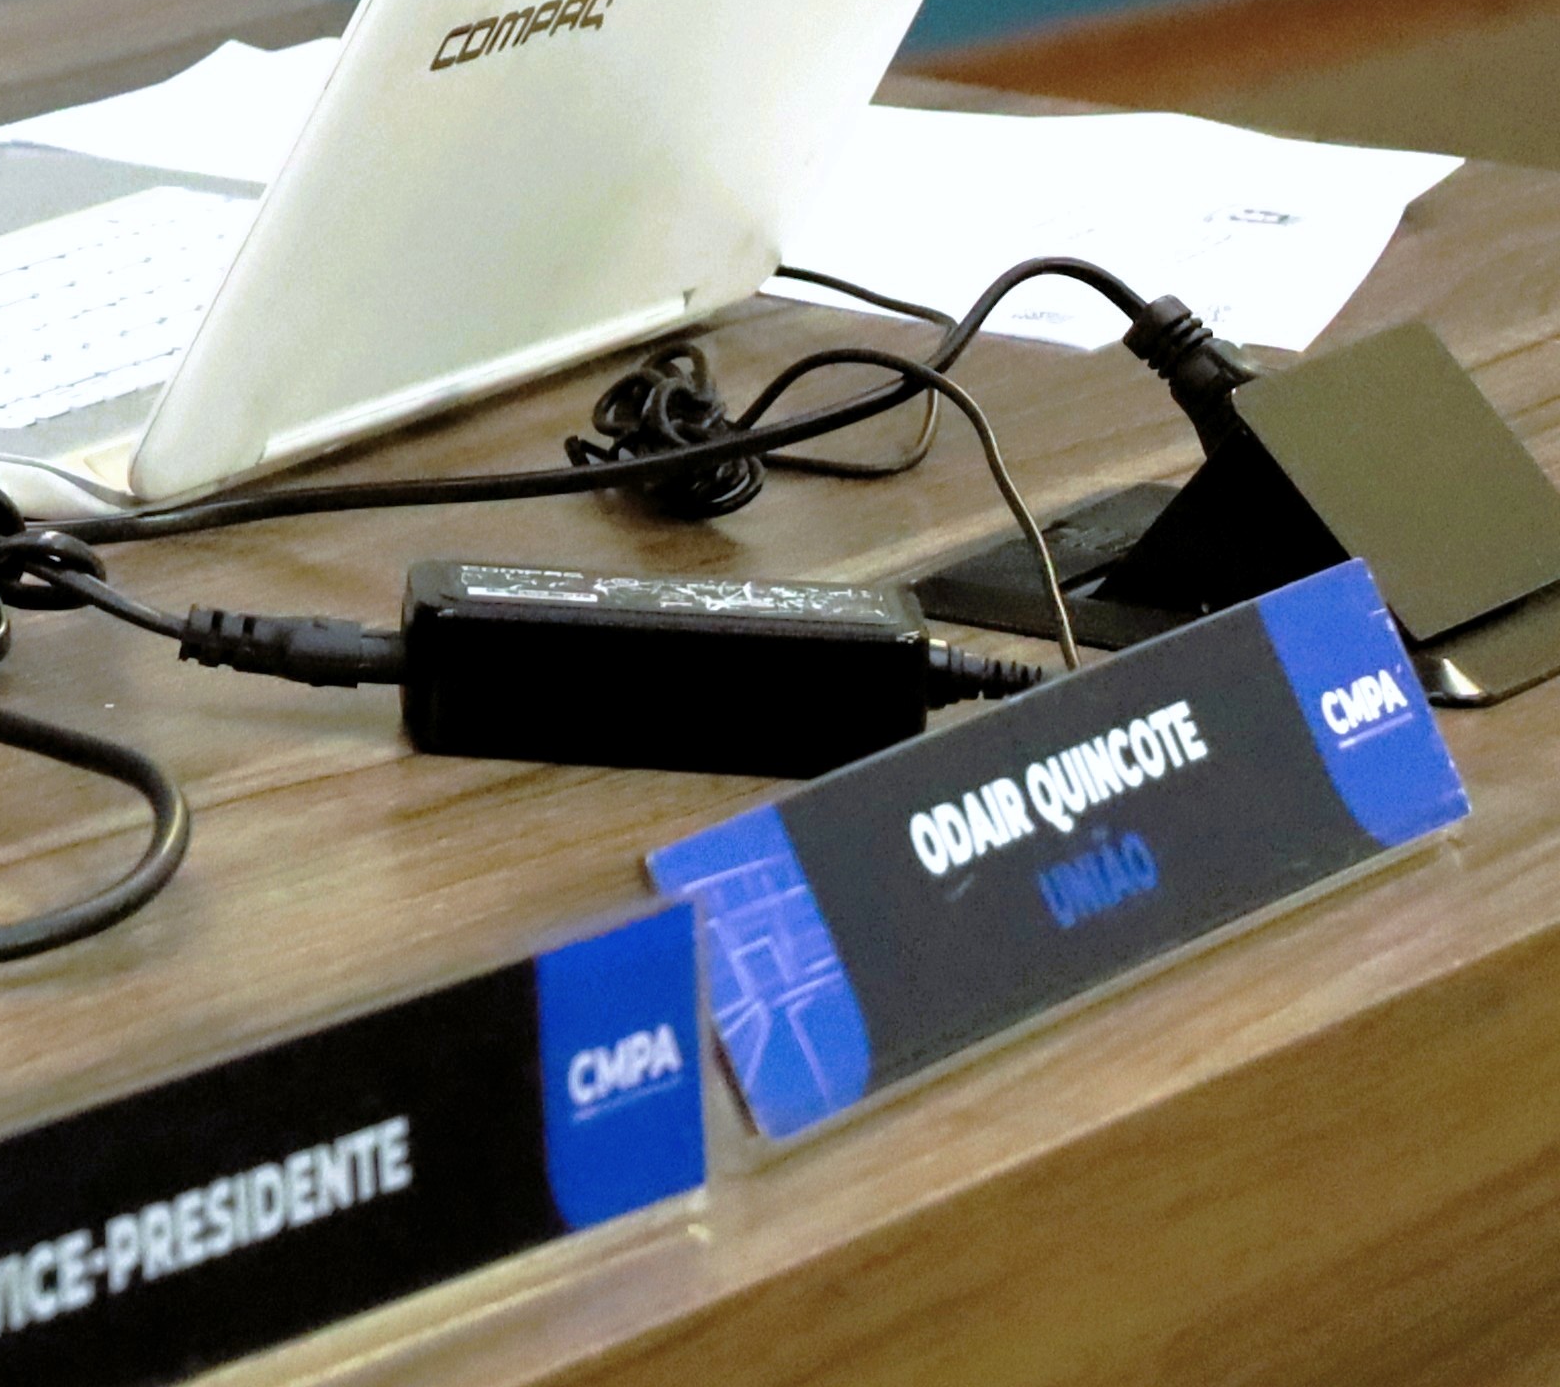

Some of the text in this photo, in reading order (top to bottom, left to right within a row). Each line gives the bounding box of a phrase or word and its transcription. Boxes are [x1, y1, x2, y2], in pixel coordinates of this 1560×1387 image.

[1321, 669, 1408, 735] CMPA
[910, 701, 1208, 875] ODAIR QUINCOTE
[1038, 826, 1159, 927] UNIÃO
[568, 1024, 683, 1105] CMPA
